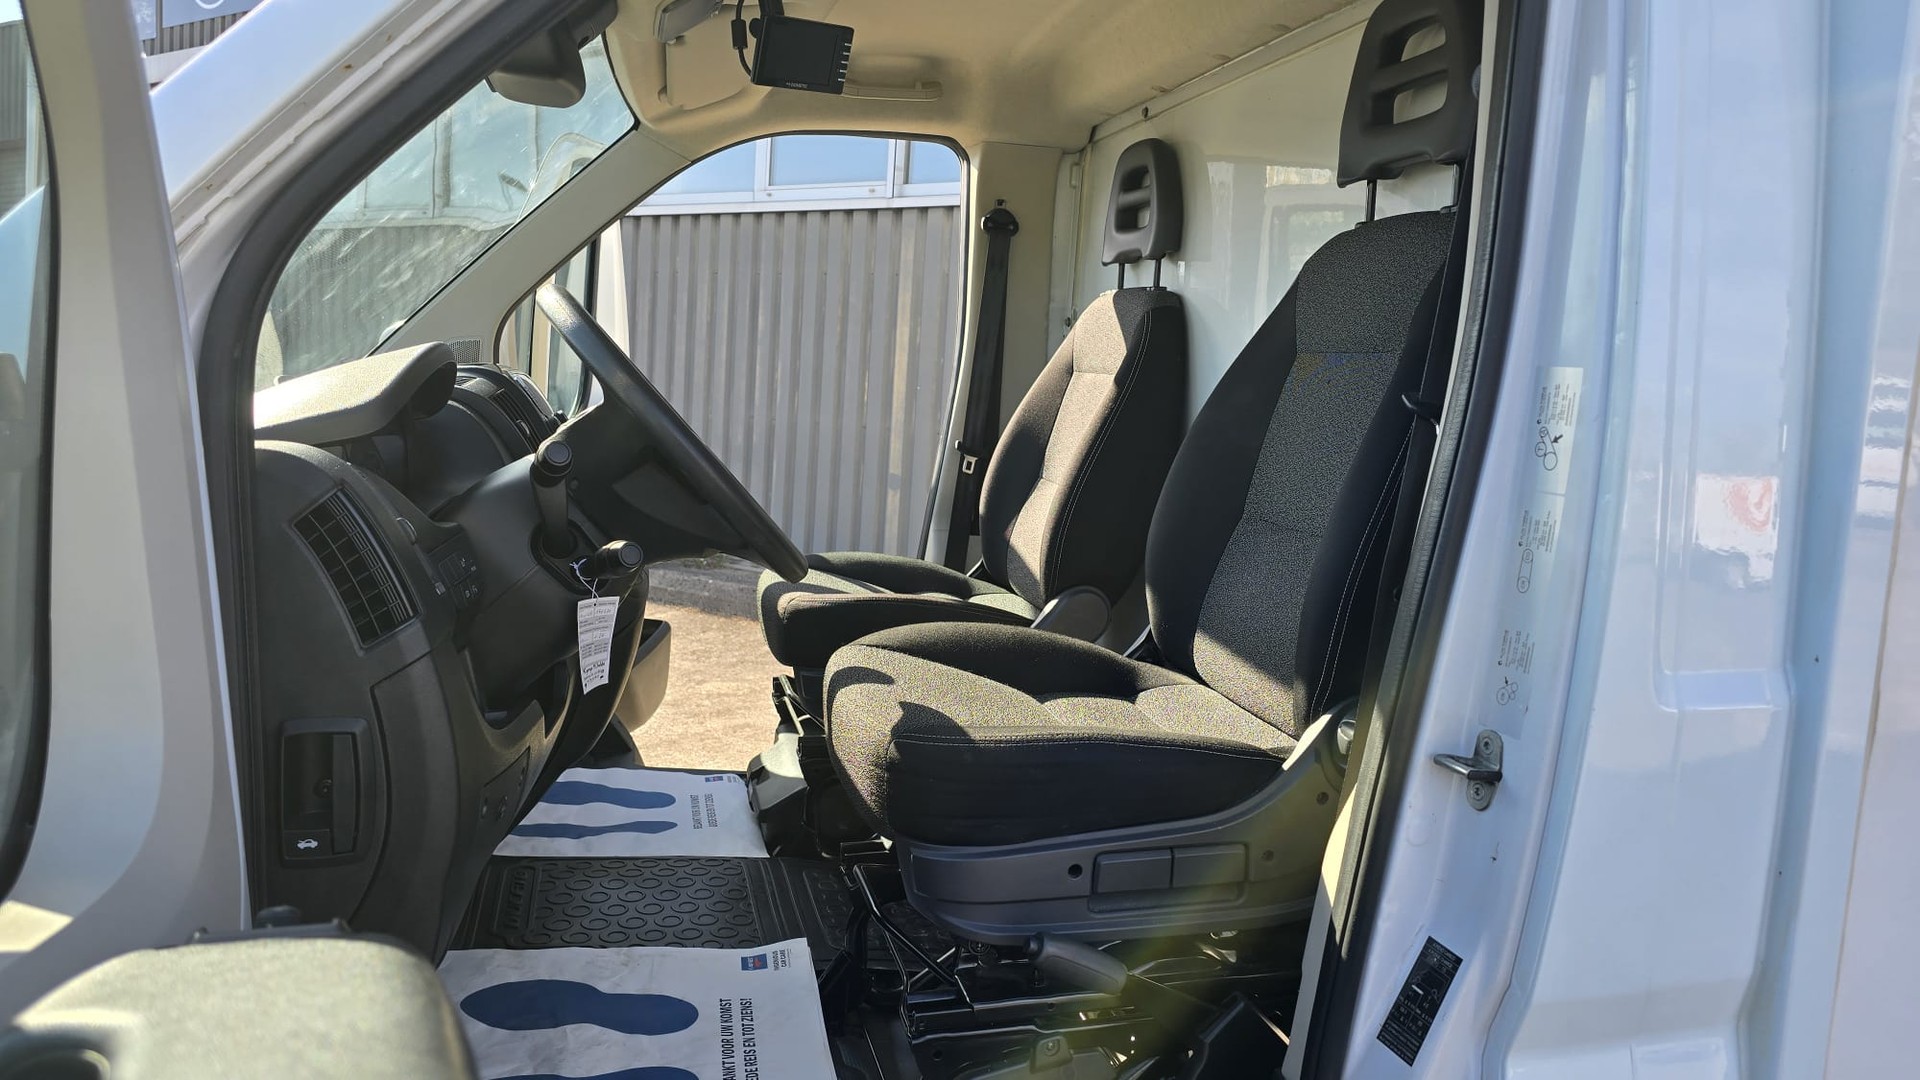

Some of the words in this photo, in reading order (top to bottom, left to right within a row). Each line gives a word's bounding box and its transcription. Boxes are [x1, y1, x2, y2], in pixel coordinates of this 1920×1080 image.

[719, 998, 733, 1023] KOMST
[739, 998, 754, 1022] ZIENS!
[720, 1024, 734, 1037] UW
[741, 1023, 755, 1036] TOT
[721, 1038, 735, 1060] VOOR
[742, 1037, 756, 1048] EN
[743, 1049, 758, 1067] REIS
[721, 1060, 736, 1080] ANKT
[745, 1067, 759, 1080] EDE
